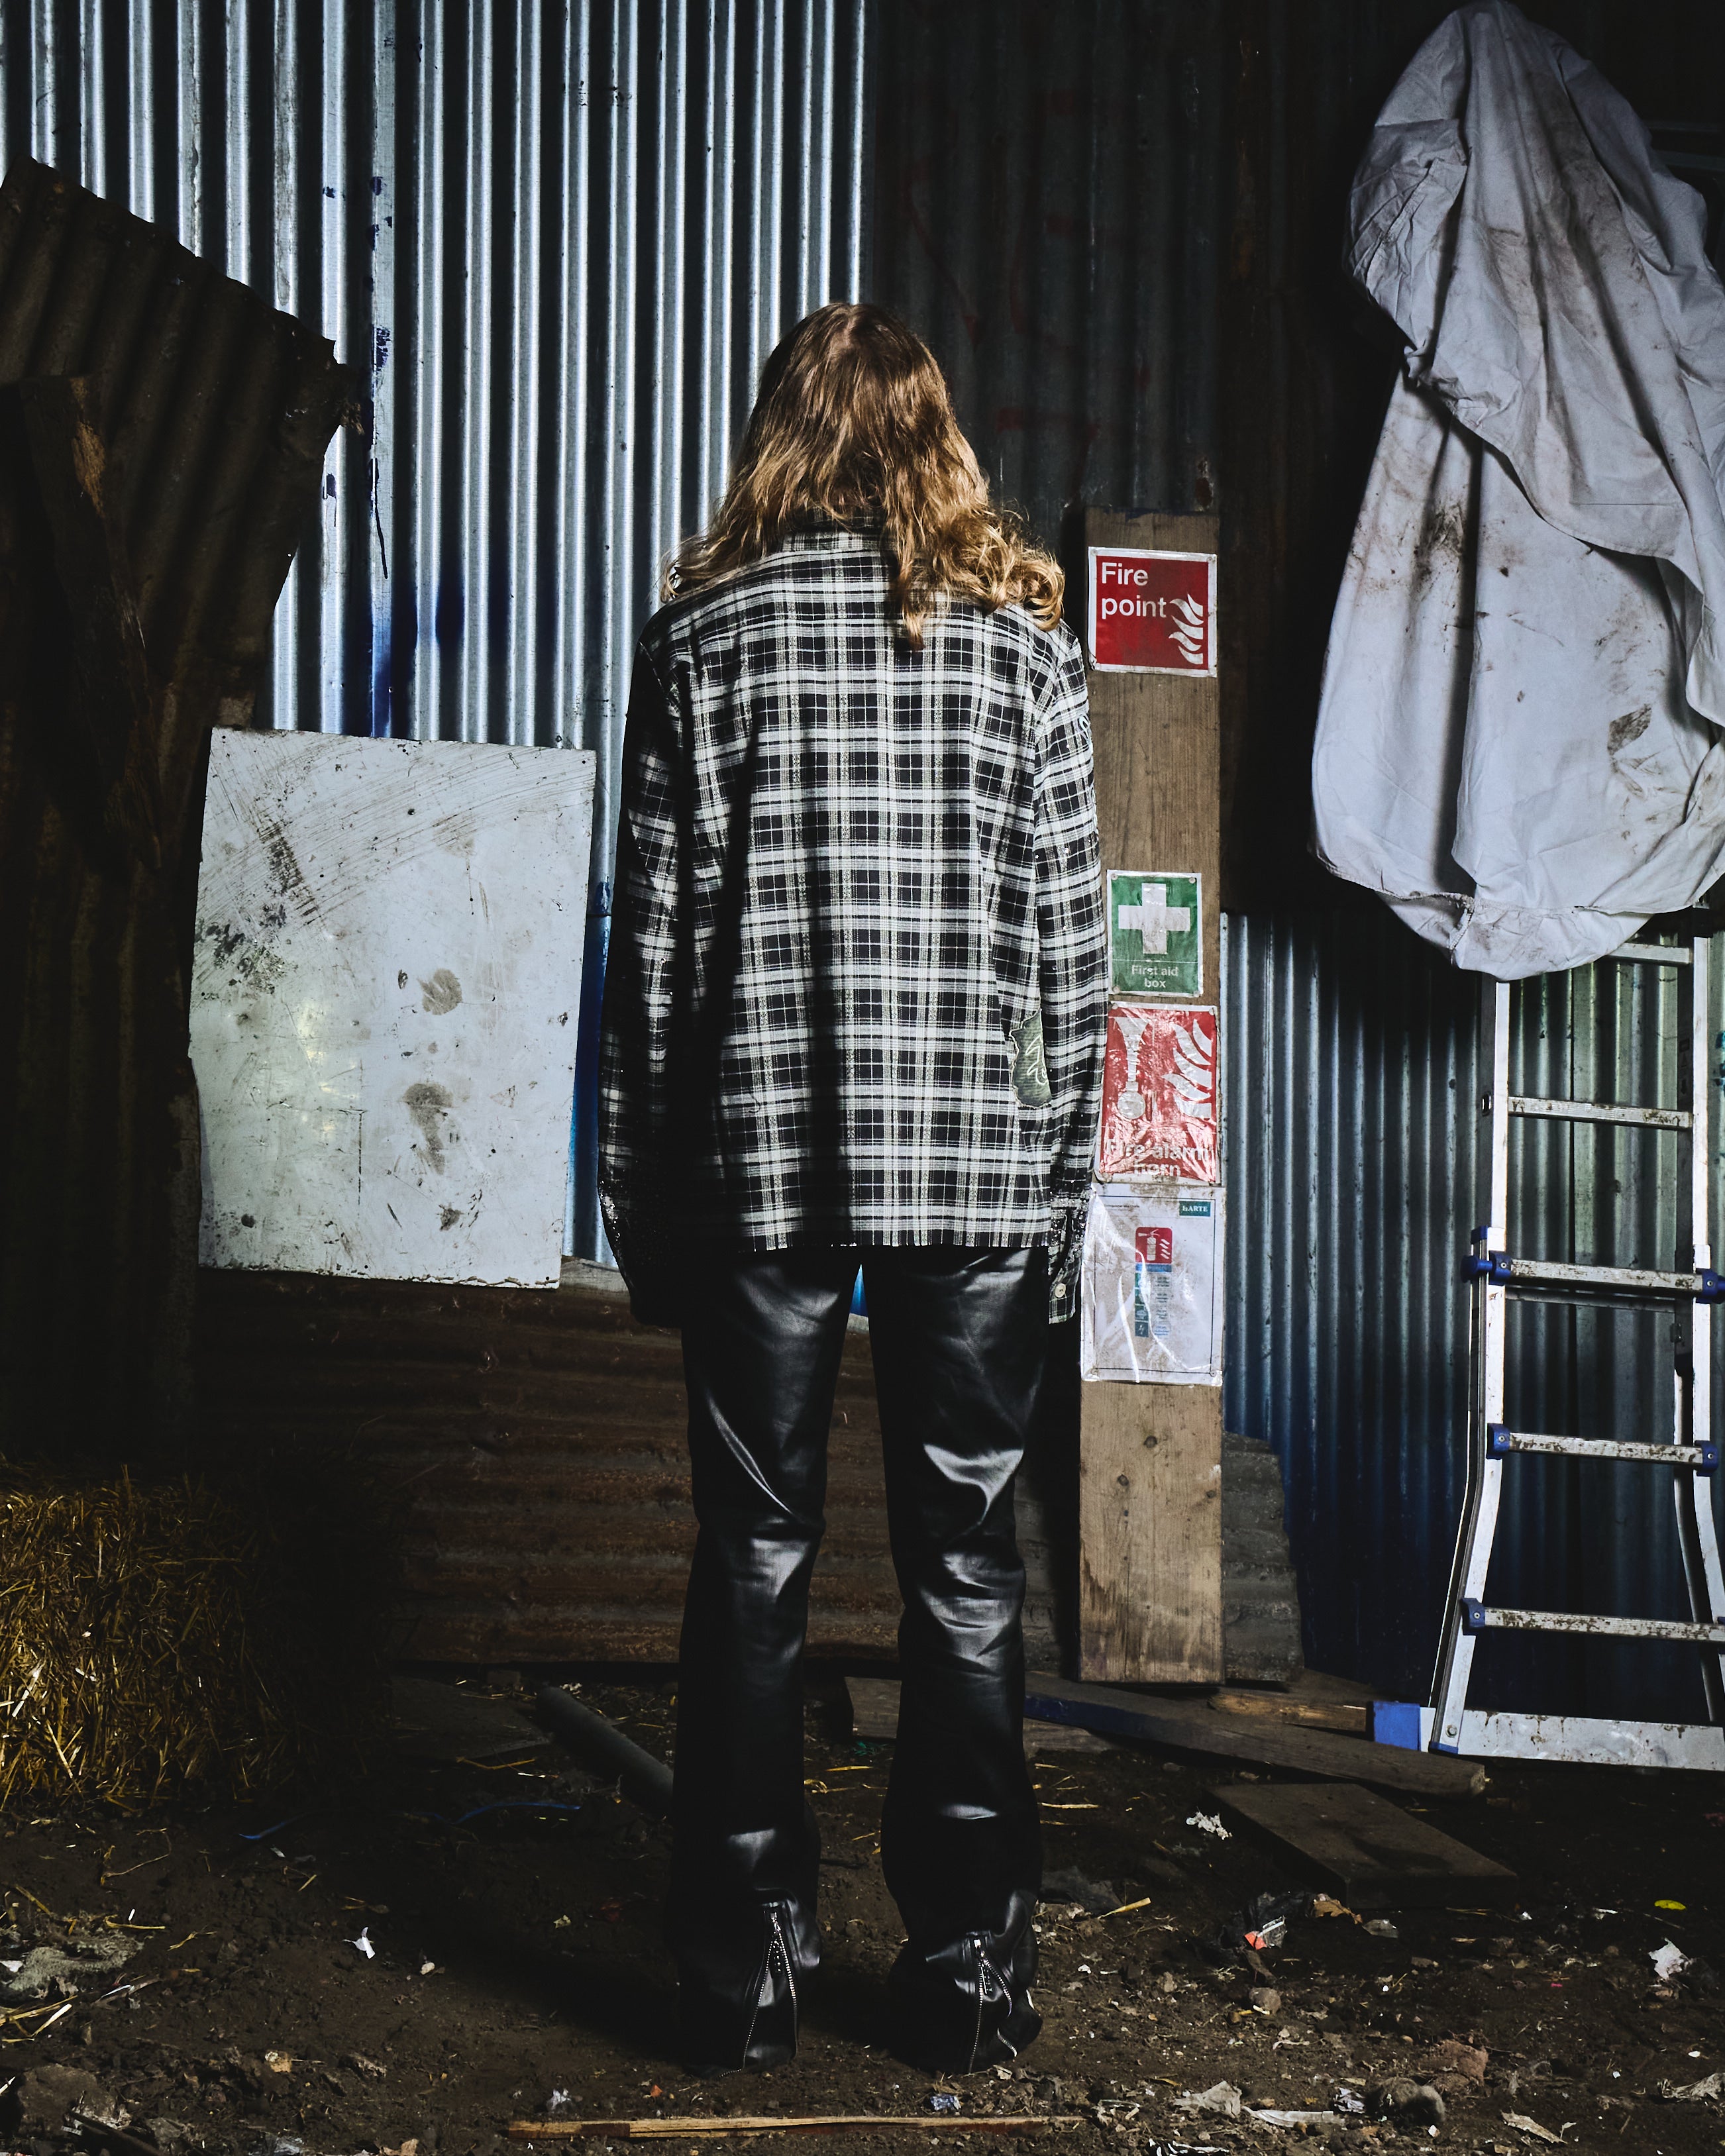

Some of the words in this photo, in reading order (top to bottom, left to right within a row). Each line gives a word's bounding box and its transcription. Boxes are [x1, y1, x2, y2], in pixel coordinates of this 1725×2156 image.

[1102, 562, 1149, 586] Fire
[1102, 595, 1167, 620] point
[1131, 965, 1158, 976] First
[1161, 966, 1179, 977] aid
[1144, 977, 1167, 988] box
[1106, 1139, 1145, 1157] Fire
[1152, 1143, 1208, 1160] alarm
[1133, 1160, 1181, 1176] horn
